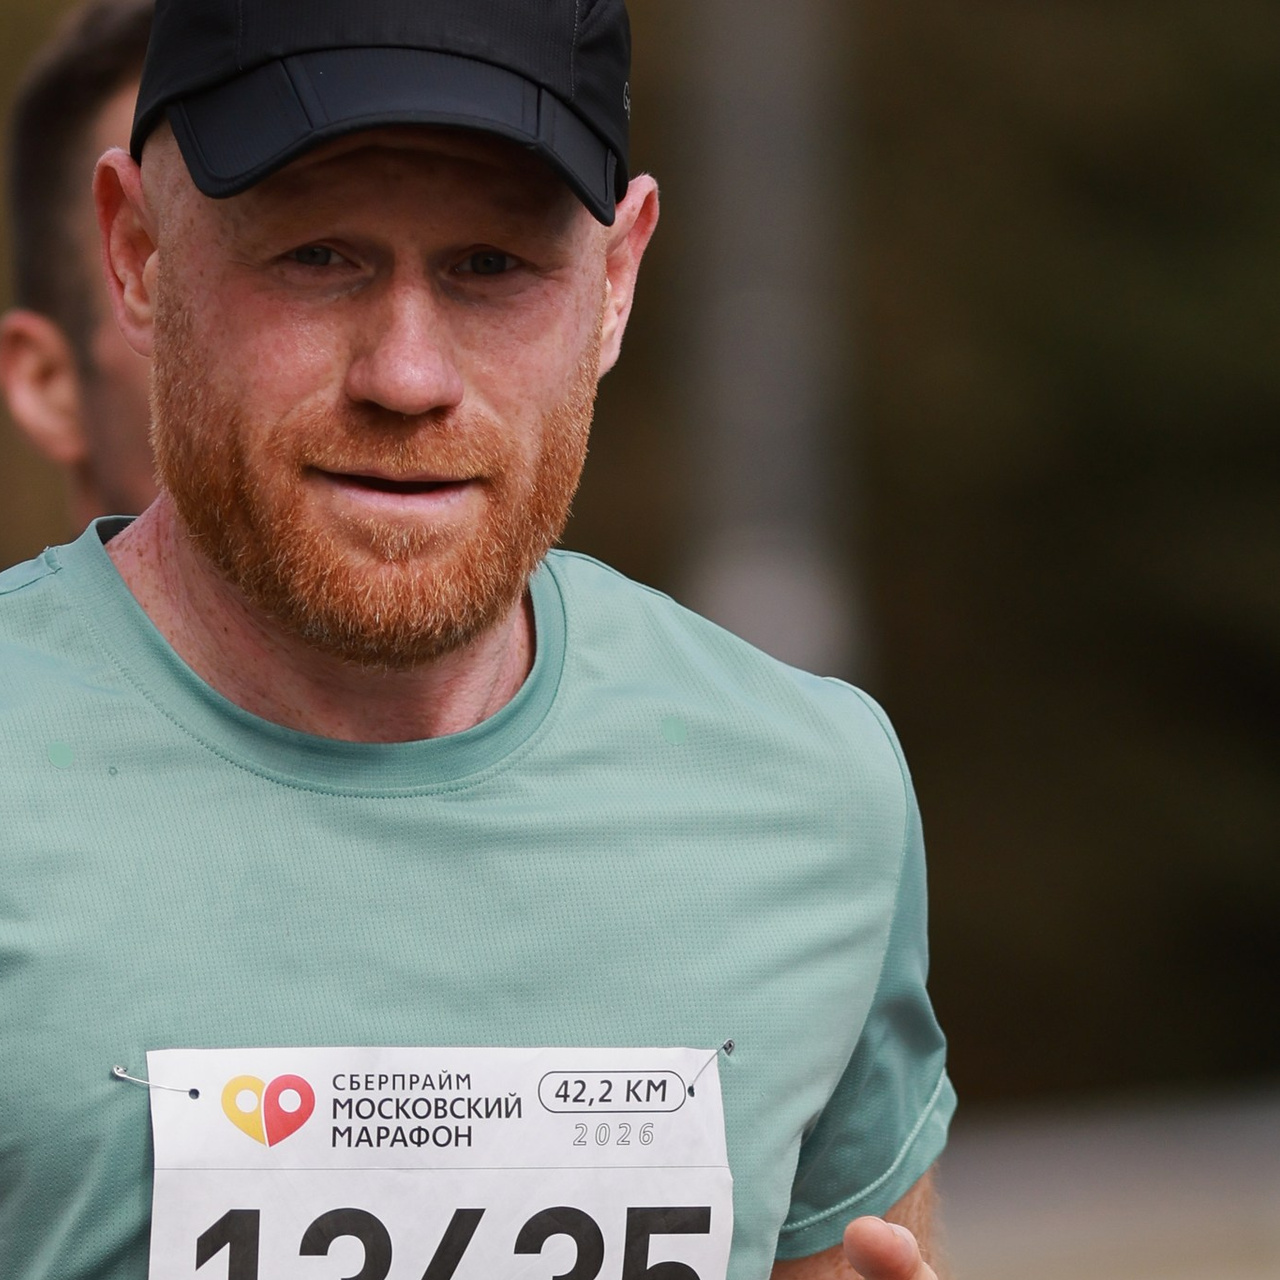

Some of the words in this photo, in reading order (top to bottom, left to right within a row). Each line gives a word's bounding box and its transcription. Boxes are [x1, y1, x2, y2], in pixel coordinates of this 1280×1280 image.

[332, 1069, 472, 1091] СБЕРПРАЙМ
[554, 1079, 613, 1107] 42,2
[625, 1078, 668, 1103] КМ
[332, 1092, 523, 1120] МОСКОВСКИЙ
[331, 1124, 473, 1148] МАРАФОН
[572, 1122, 655, 1147] 2026
